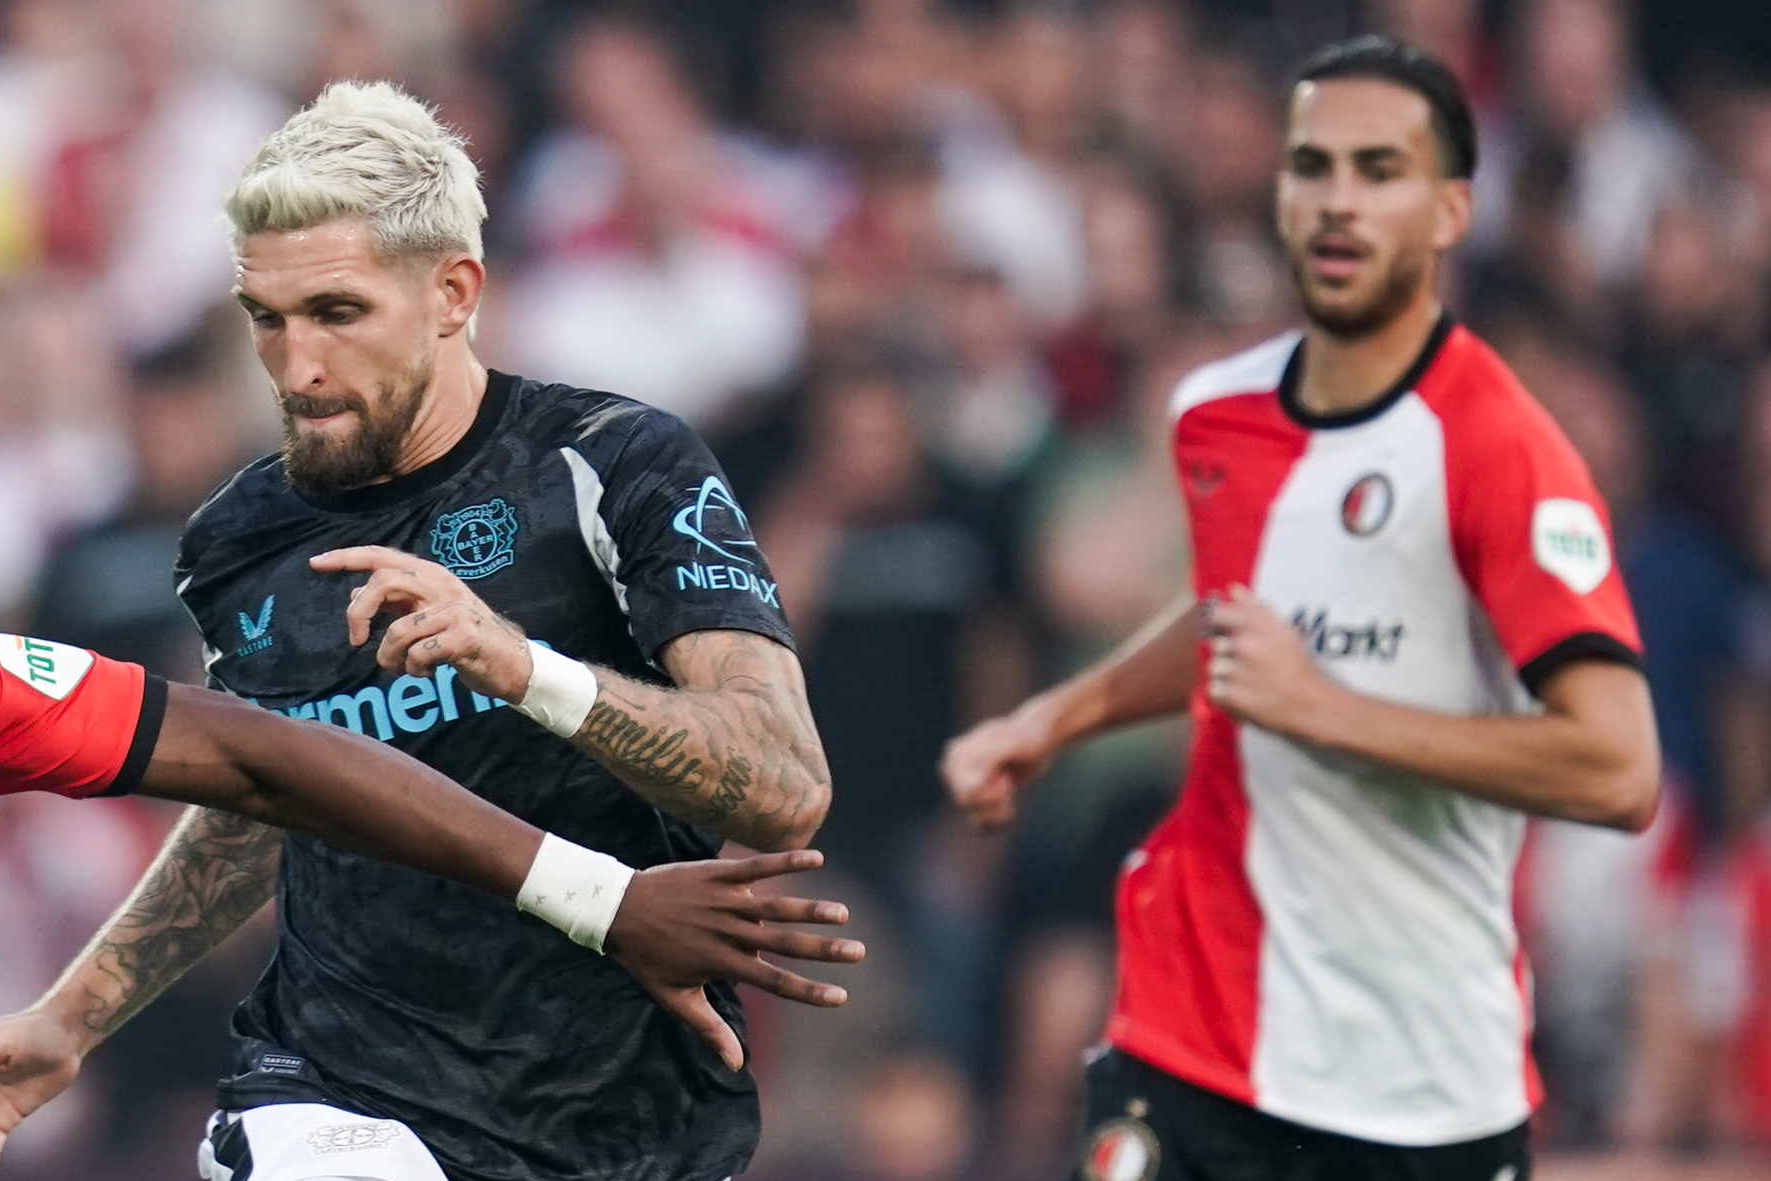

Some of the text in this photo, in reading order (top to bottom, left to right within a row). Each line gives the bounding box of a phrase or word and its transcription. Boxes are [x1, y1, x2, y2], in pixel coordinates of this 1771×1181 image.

[457, 534, 495, 551] BAYER
[468, 523, 483, 562] BAYER
[676, 561, 780, 609] NIEDAX
[238, 636, 273, 656] CASTORE
